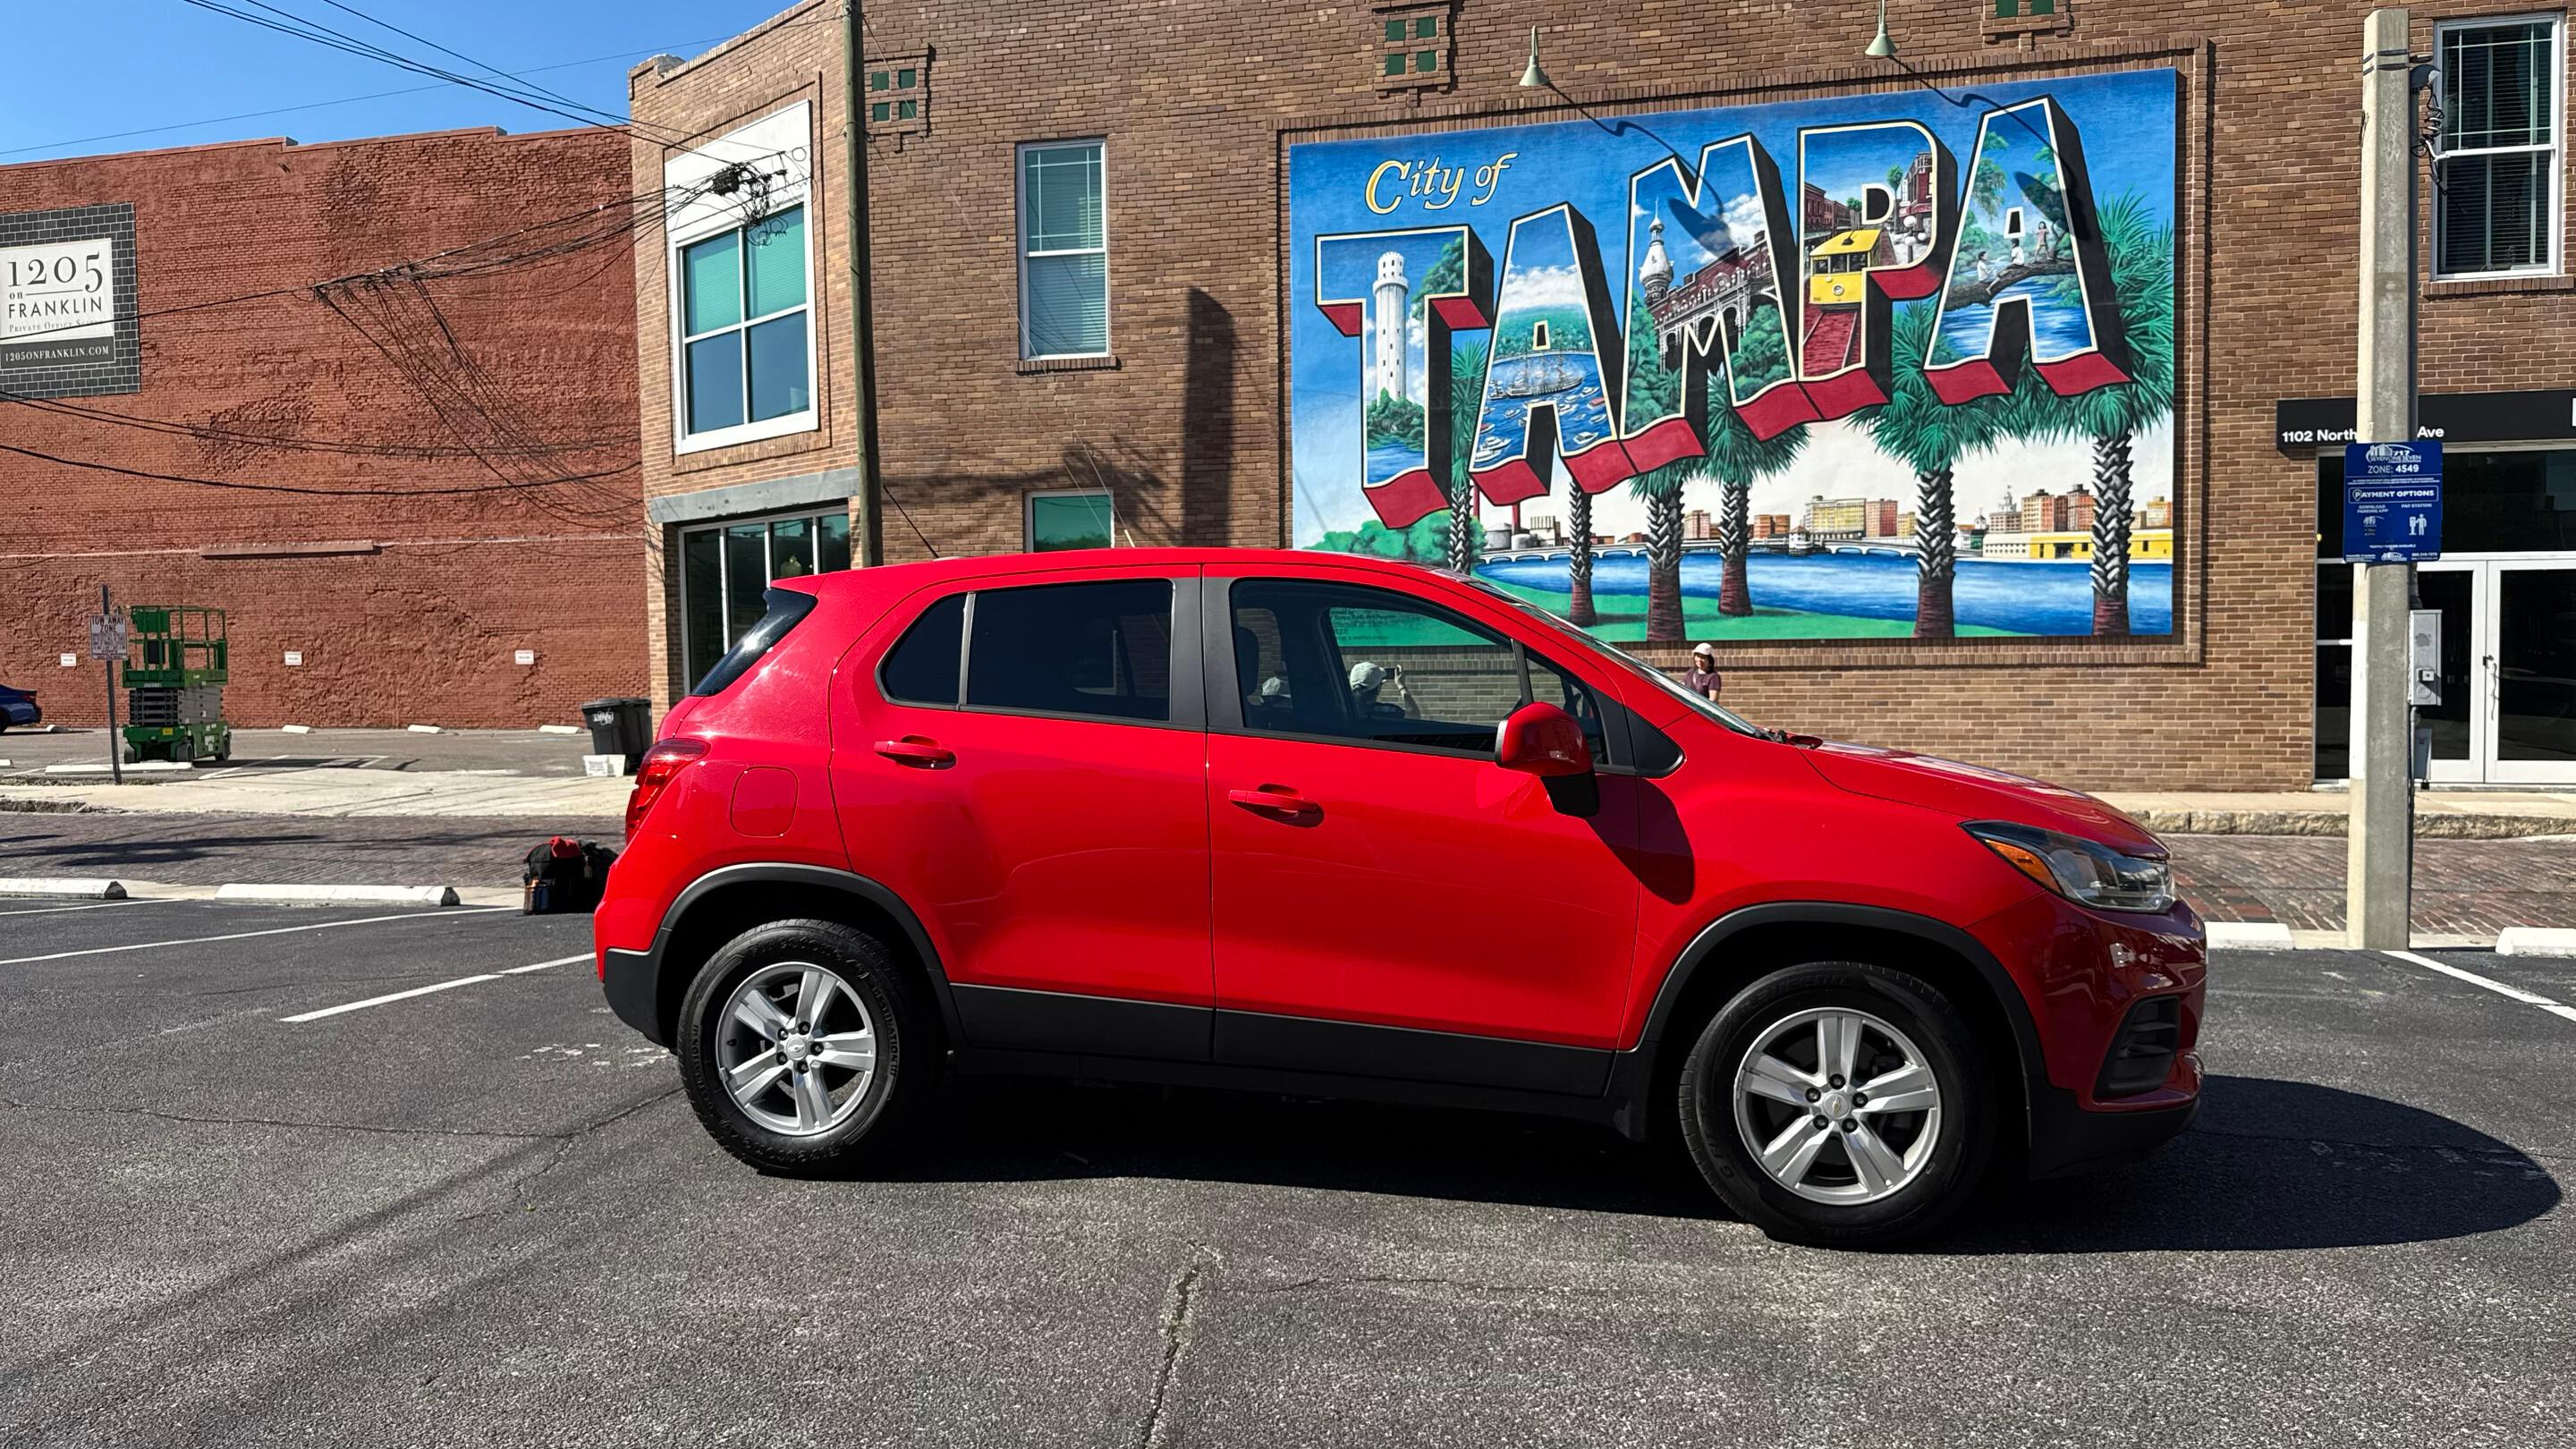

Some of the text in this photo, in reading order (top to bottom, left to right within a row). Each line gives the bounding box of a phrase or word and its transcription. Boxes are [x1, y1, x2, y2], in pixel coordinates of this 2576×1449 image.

[1365, 152, 1521, 216] City of
[7, 251, 103, 292] 1205
[9, 292, 23, 300] on
[8, 296, 103, 318] FRANKLIN
[1314, 94, 2132, 528] TAMPA
[5, 345, 110, 361] 1205ONFRANKLIN.COM
[2282, 426, 2445, 443] 1102 North Ave
[2368, 463, 2419, 474] ZONE: 4549
[2353, 489, 2435, 499] PAYMENT OPTIONS
[92, 615, 124, 625] TOW AWAY
[100, 624, 117, 633] ZONE
